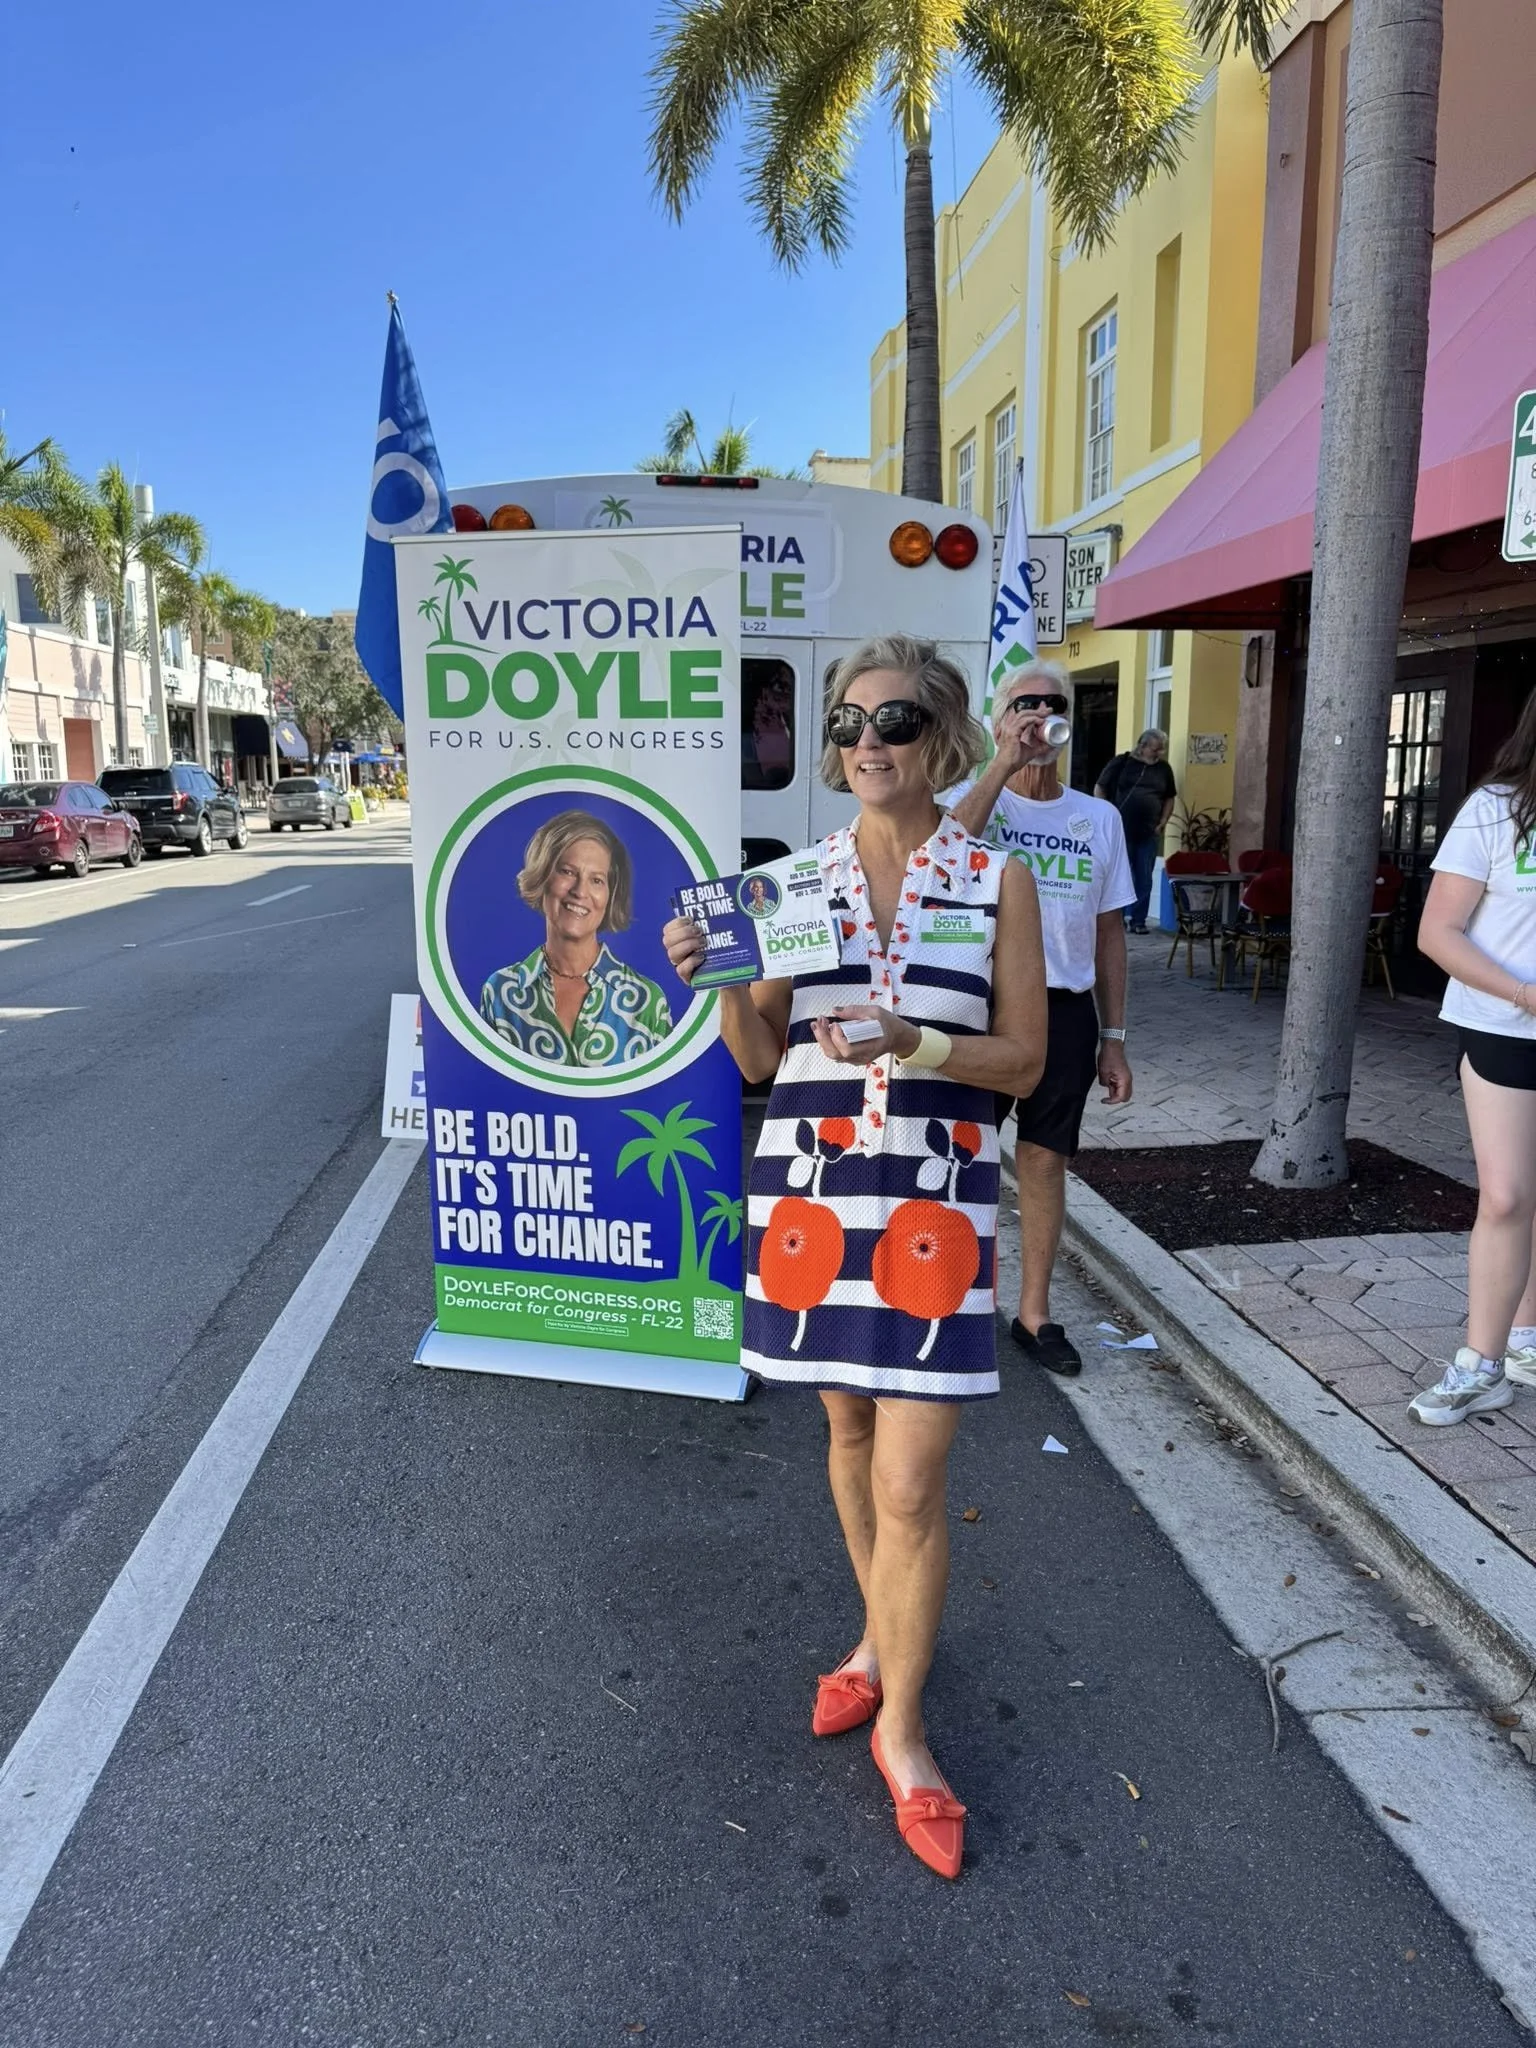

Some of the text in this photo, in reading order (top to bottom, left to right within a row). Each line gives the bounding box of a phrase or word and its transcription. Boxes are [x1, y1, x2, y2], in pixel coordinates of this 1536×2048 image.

[463, 596, 718, 640] VICTORIA
[741, 621, 767, 632] L-22
[1069, 641, 1080, 658] 113
[426, 650, 724, 721] DOYLE
[429, 730, 725, 749] FOR U.S. CONGRESS
[1001, 827, 1093, 856] VICTORIA
[1010, 848, 1093, 883] OYLE
[680, 882, 729, 905] BE BOLD.
[706, 897, 735, 917] TIME
[772, 919, 826, 936] VICTORIA
[933, 920, 972, 928] DOYLE
[705, 930, 738, 951] ANGE.
[766, 929, 831, 955] DOYLE
[433, 1108, 589, 1162] BE BOLD.
[435, 1157, 594, 1212] IT'S TIME
[438, 1206, 663, 1269] FOR CHANGE.
[444, 1294, 523, 1313] Democrat
[527, 1301, 549, 1315] for
[553, 1304, 628, 1324] Congress
[641, 1313, 684, 1330] FL-22
